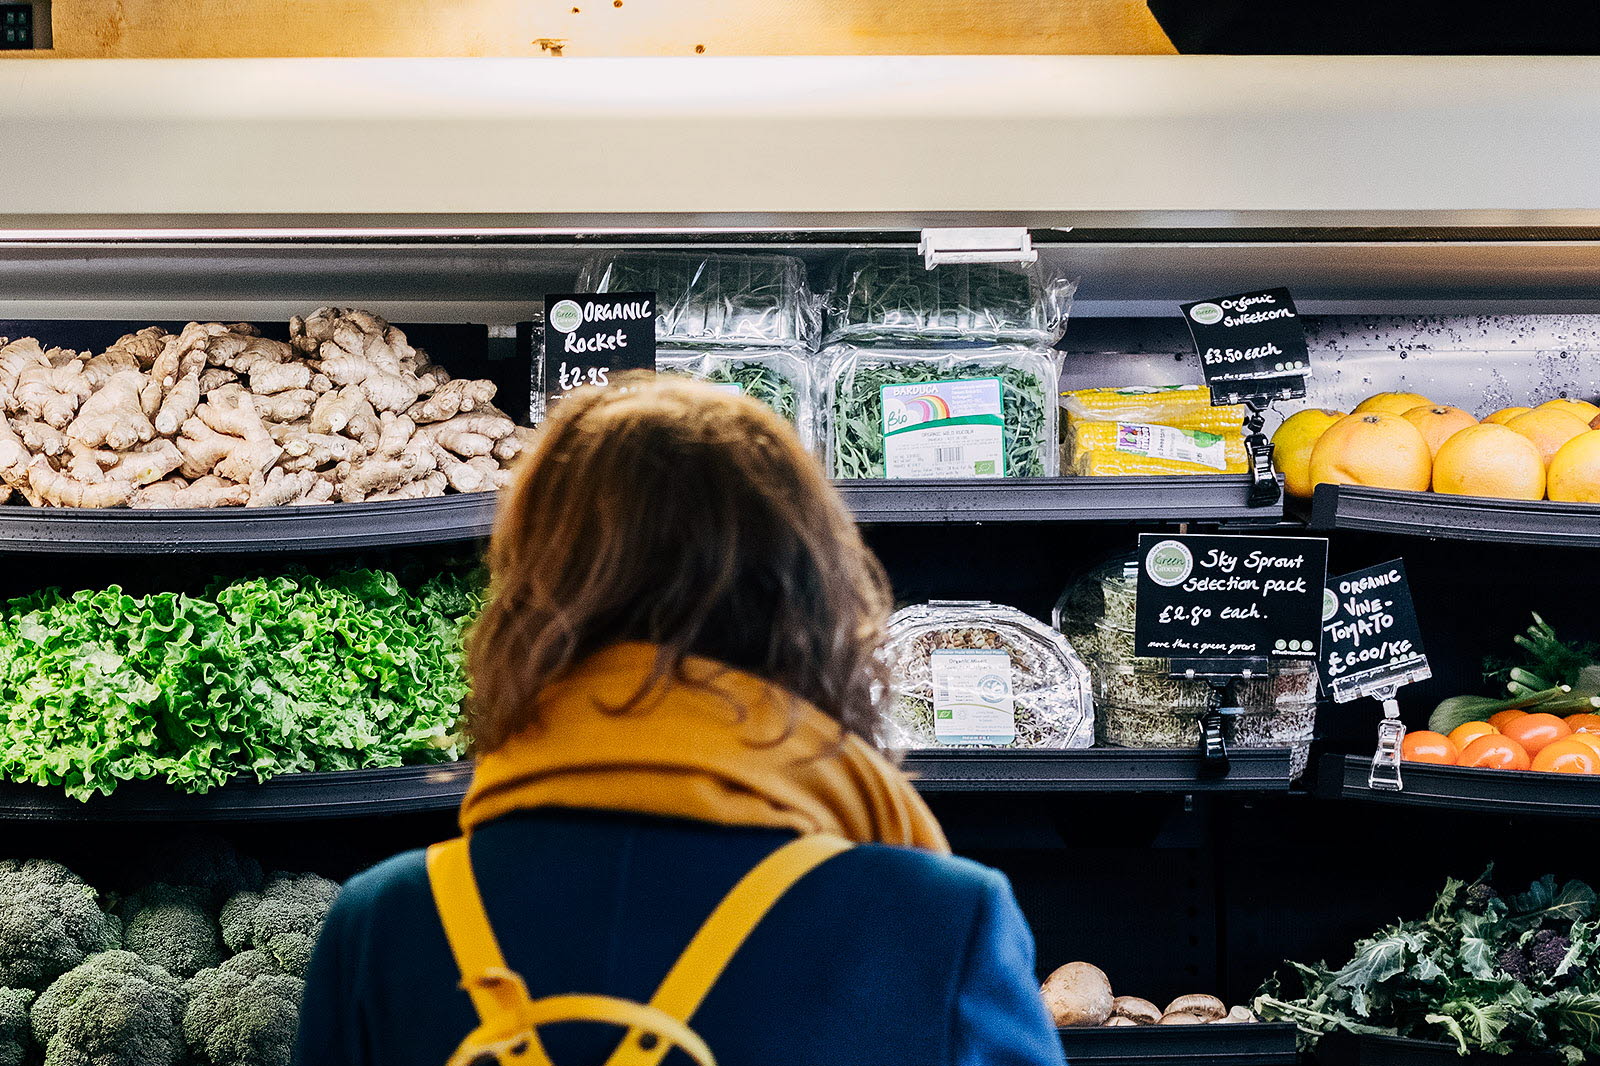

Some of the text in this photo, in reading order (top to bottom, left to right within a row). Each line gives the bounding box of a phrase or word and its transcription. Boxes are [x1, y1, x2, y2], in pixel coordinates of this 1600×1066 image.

[583, 300, 652, 323] ORGANIC
[1220, 294, 1276, 313] Organic
[1223, 308, 1295, 328] Sweetcorn
[564, 328, 628, 354] Rocket
[1204, 342, 1283, 365] £3.50 each
[558, 361, 610, 391] £2.95
[893, 384, 939, 396] BARDUCA
[1199, 548, 1305, 574] Sky Sprout
[1182, 576, 1308, 597] Selection pack
[1339, 569, 1402, 595] ORGANIC
[1323, 611, 1394, 647] TOMATO
